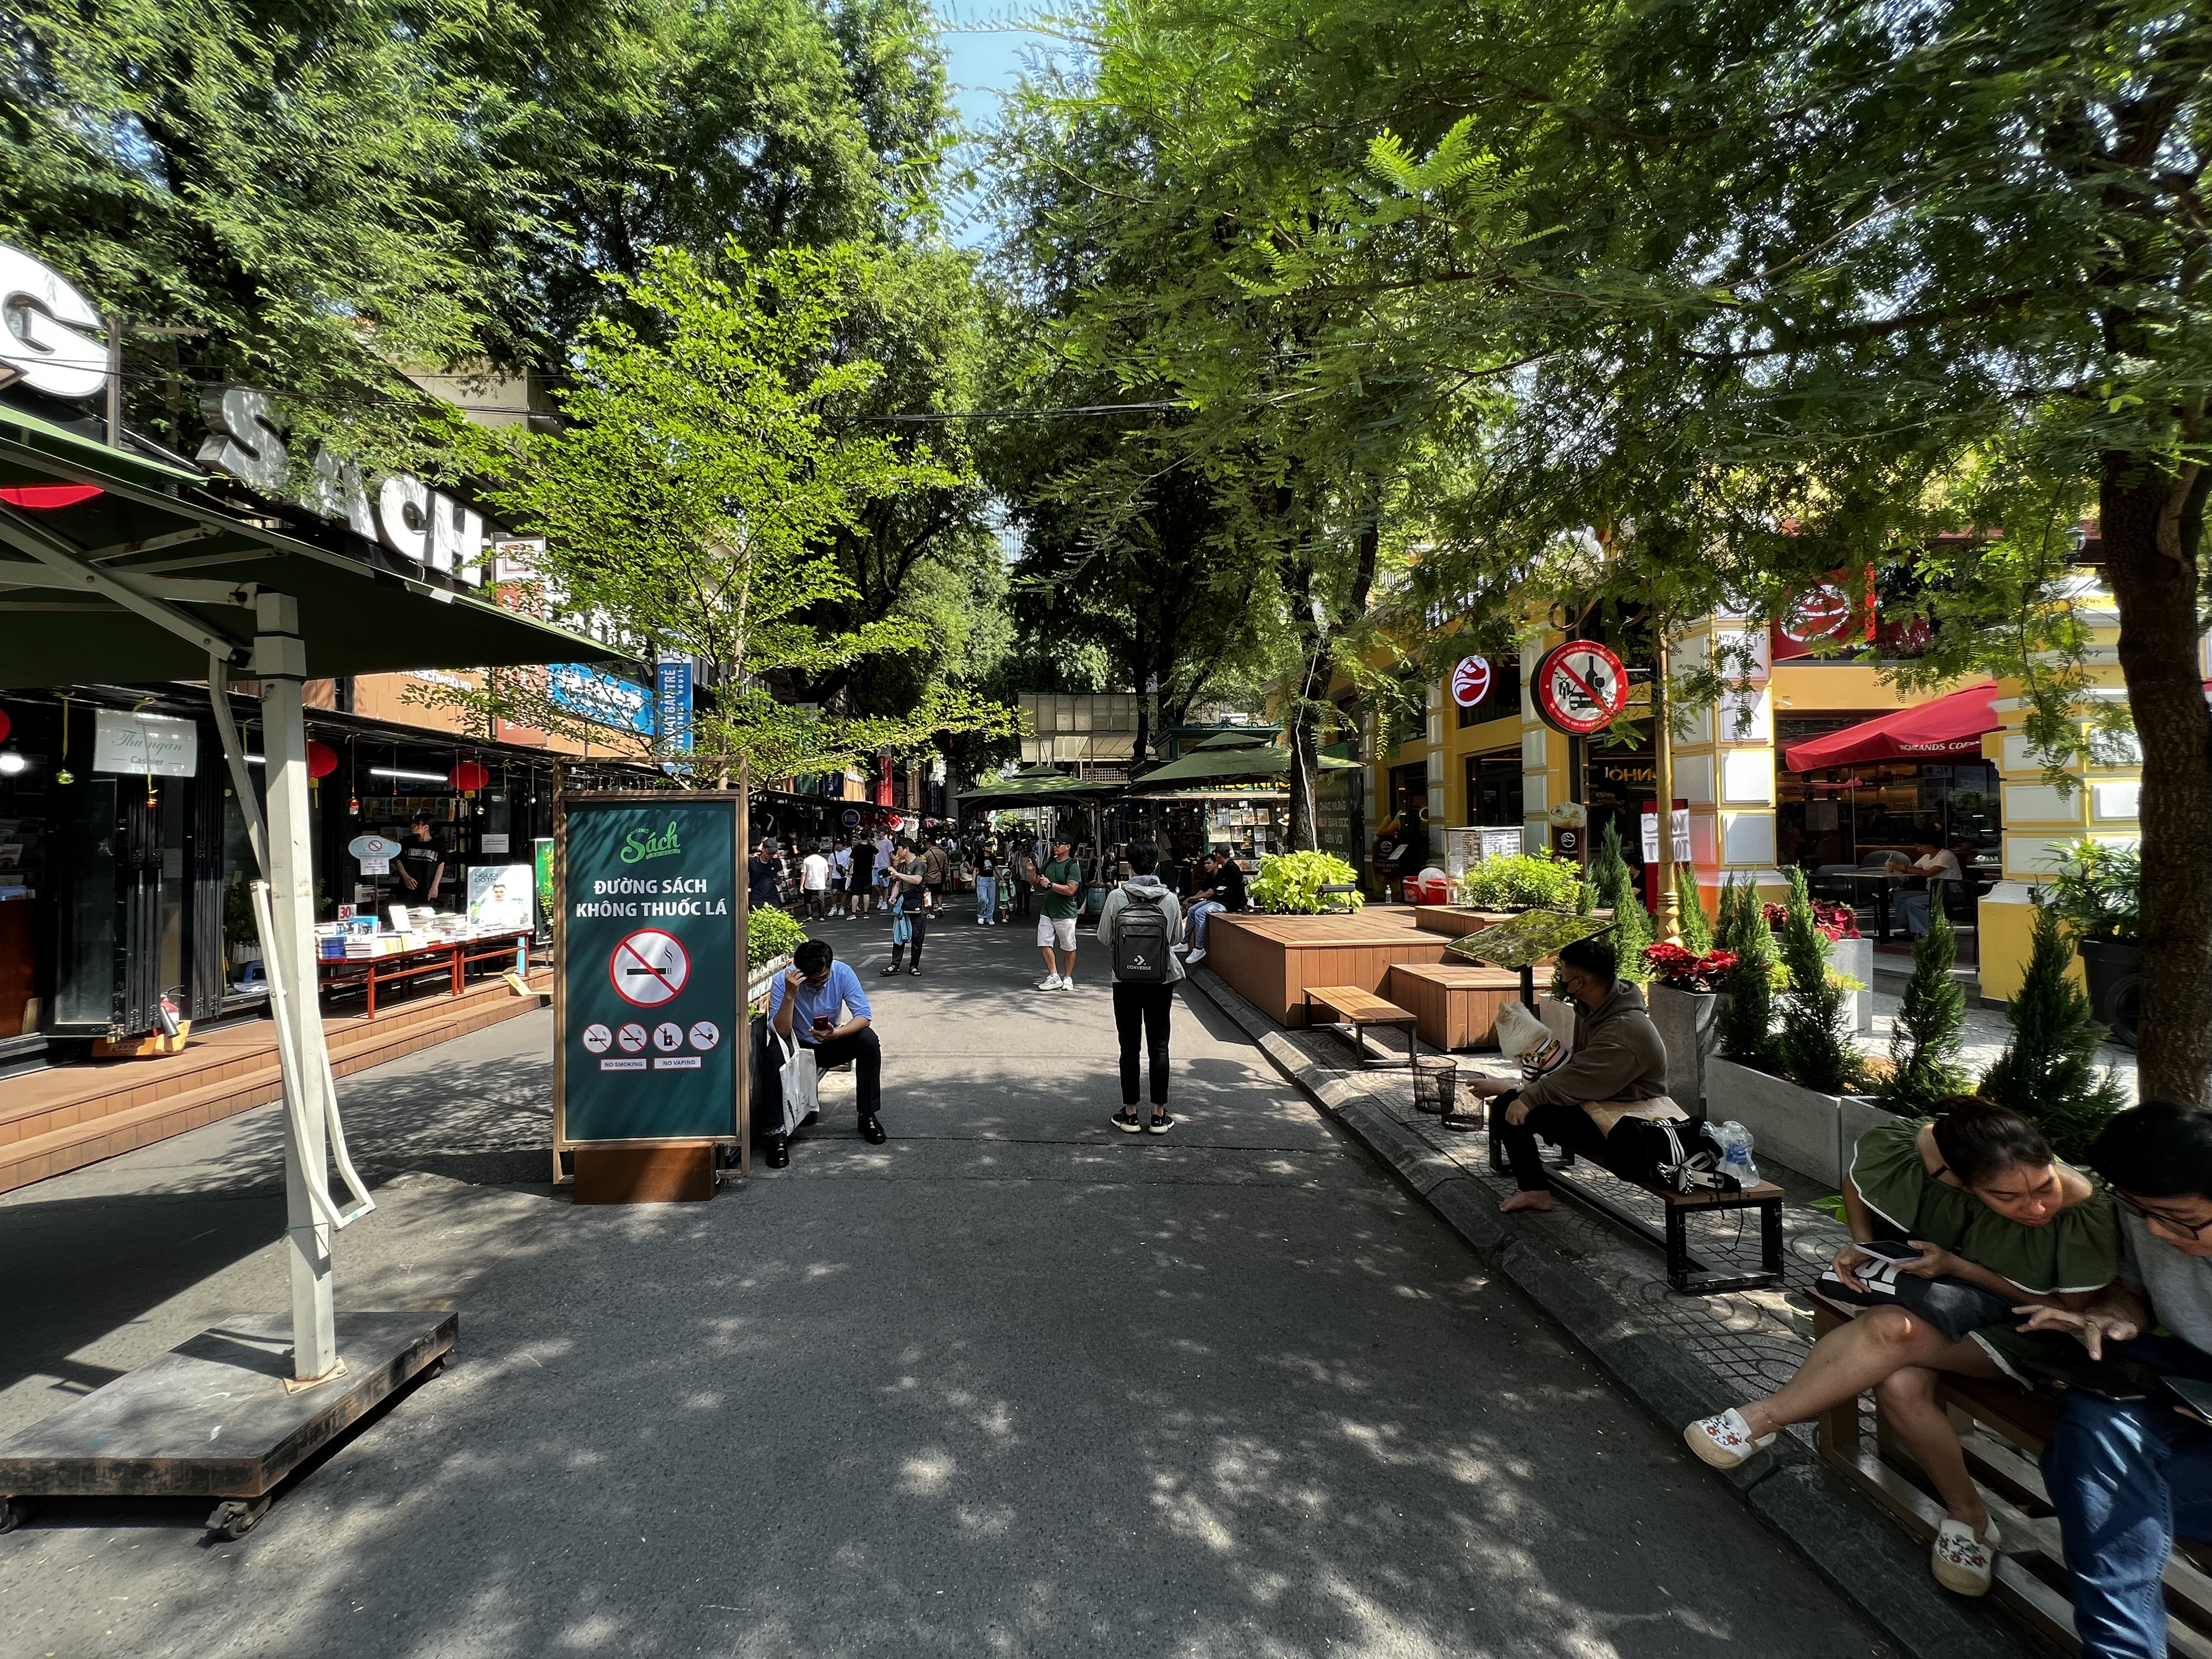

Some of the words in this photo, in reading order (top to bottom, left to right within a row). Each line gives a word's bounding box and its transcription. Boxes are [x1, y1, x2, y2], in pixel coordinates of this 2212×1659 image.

[660, 669, 676, 690] TRẺ
[131, 756, 164, 765] Cashier
[620, 821, 681, 863] Sách
[593, 877, 658, 895] ĐƯỜNG
[662, 877, 707, 894] SÁCH
[576, 900, 637, 917] KHÔNG
[641, 898, 701, 917] THUỐC
[705, 899, 727, 915] LÁ
